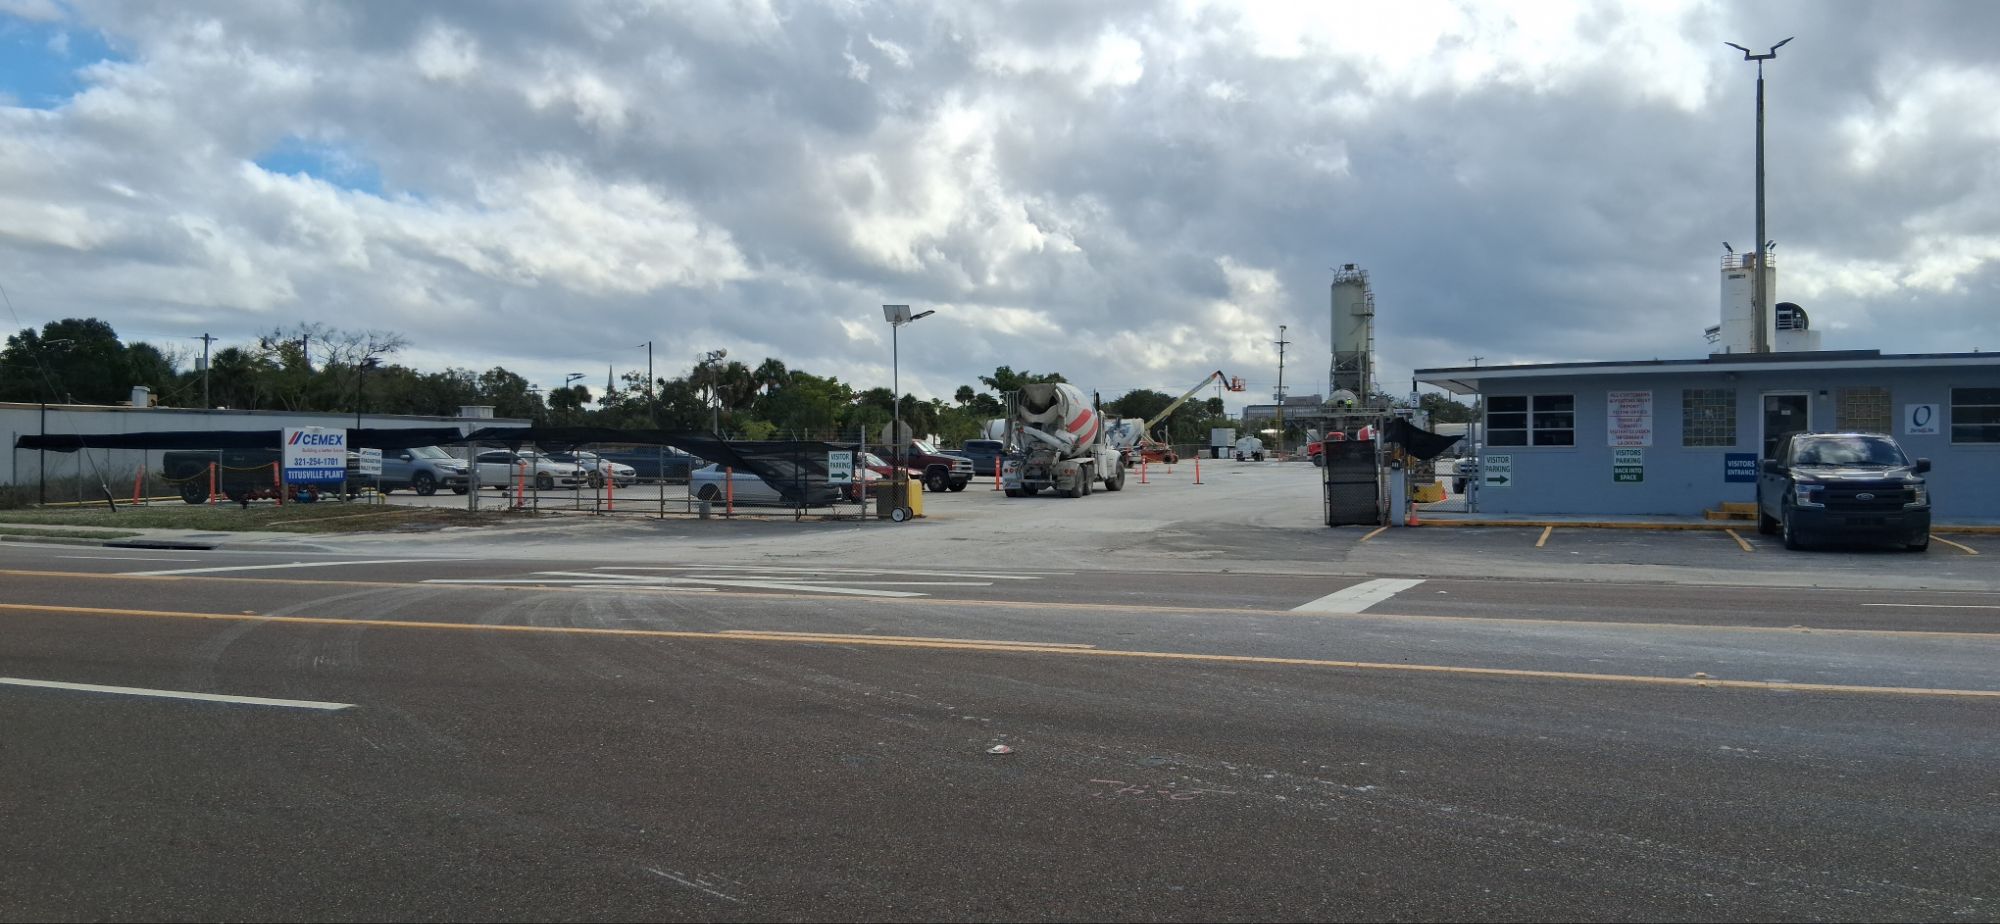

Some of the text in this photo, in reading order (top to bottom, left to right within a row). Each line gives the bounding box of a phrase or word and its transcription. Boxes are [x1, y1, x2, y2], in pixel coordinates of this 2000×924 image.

[302, 434, 344, 446] CEMEX
[1727, 460, 1755, 468] VISITORS
[1485, 465, 1510, 473] PARKING
[288, 471, 344, 479] TITUSVILLE PLANT
